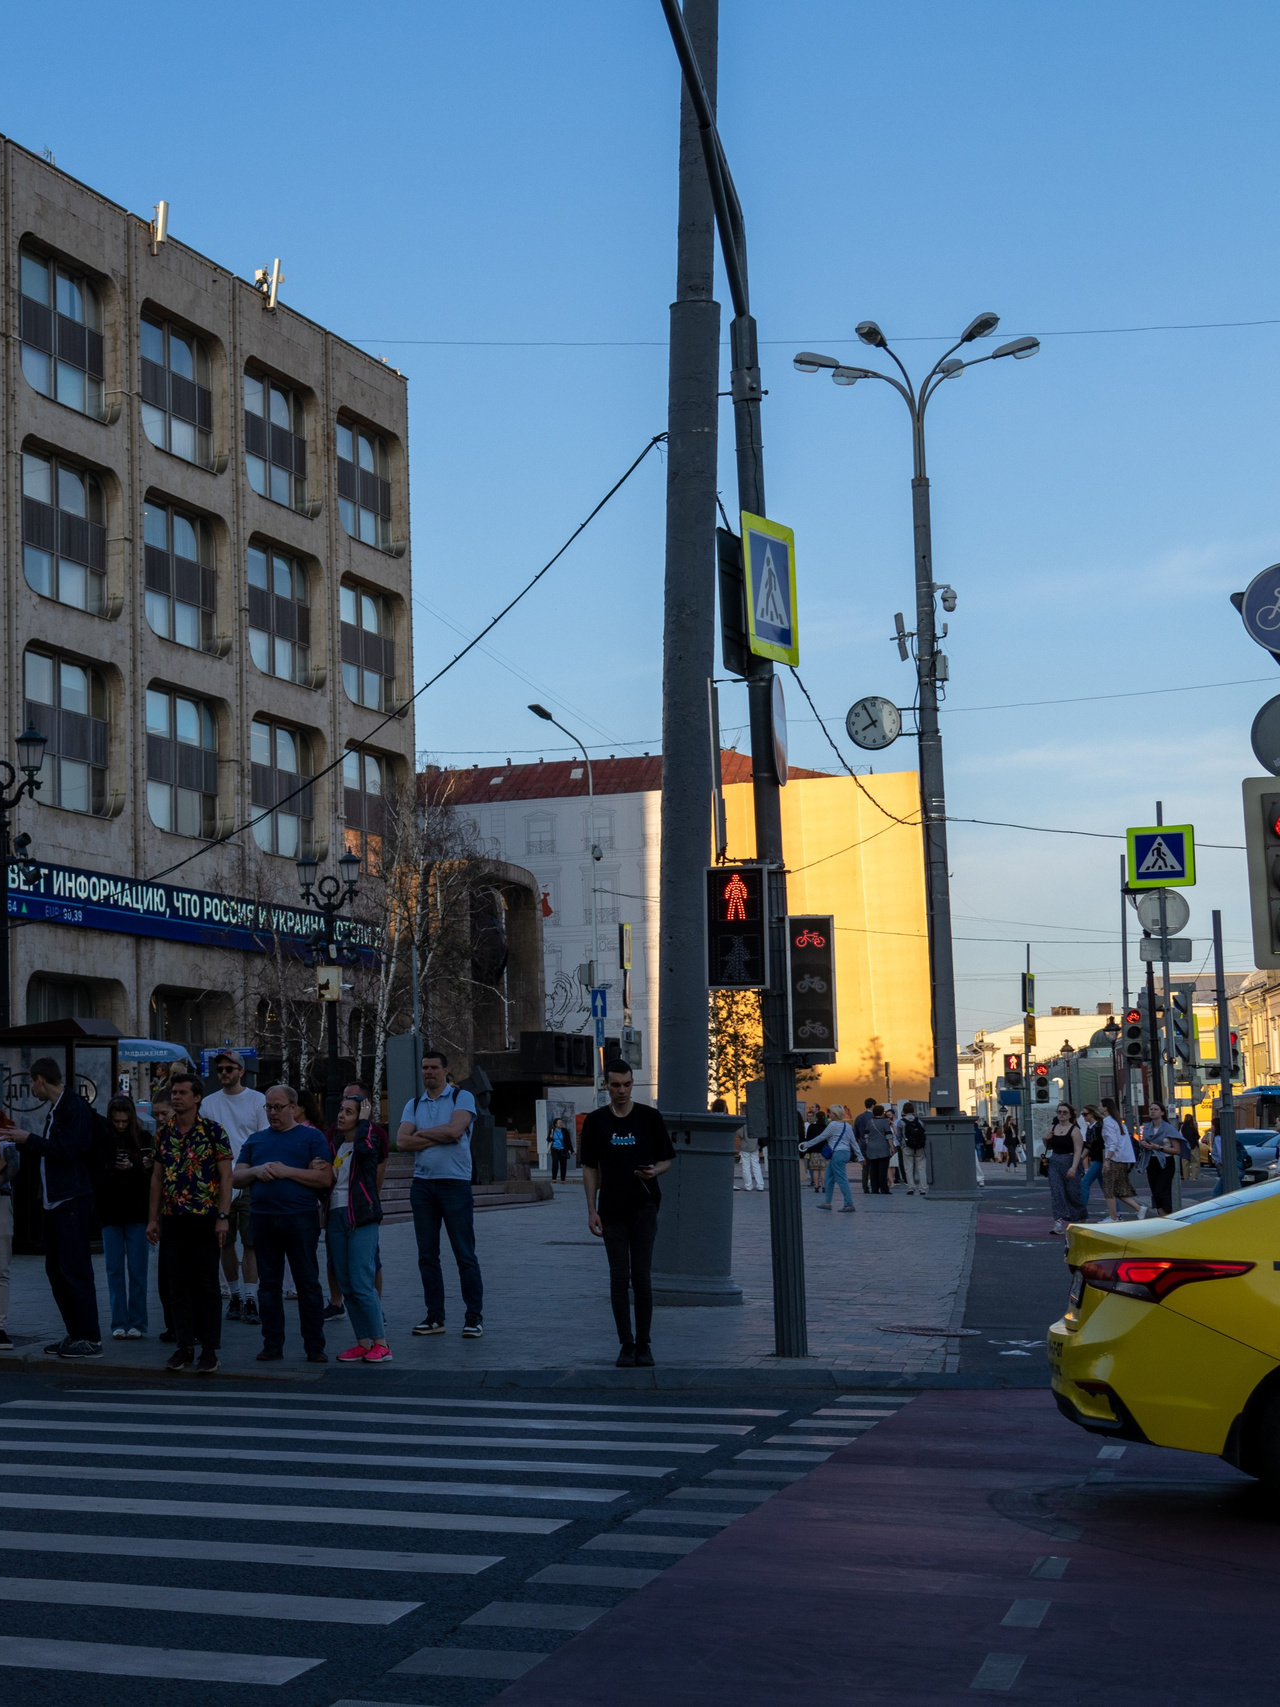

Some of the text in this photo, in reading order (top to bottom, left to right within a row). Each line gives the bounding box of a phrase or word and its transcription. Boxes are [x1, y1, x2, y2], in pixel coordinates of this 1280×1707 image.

[53, 869, 170, 918] ИНФОРМАЦИЮ,
[173, 890, 201, 919] ЧТО
[204, 896, 254, 926] РОССИЯ
[270, 909, 325, 935] УКРАИНА
